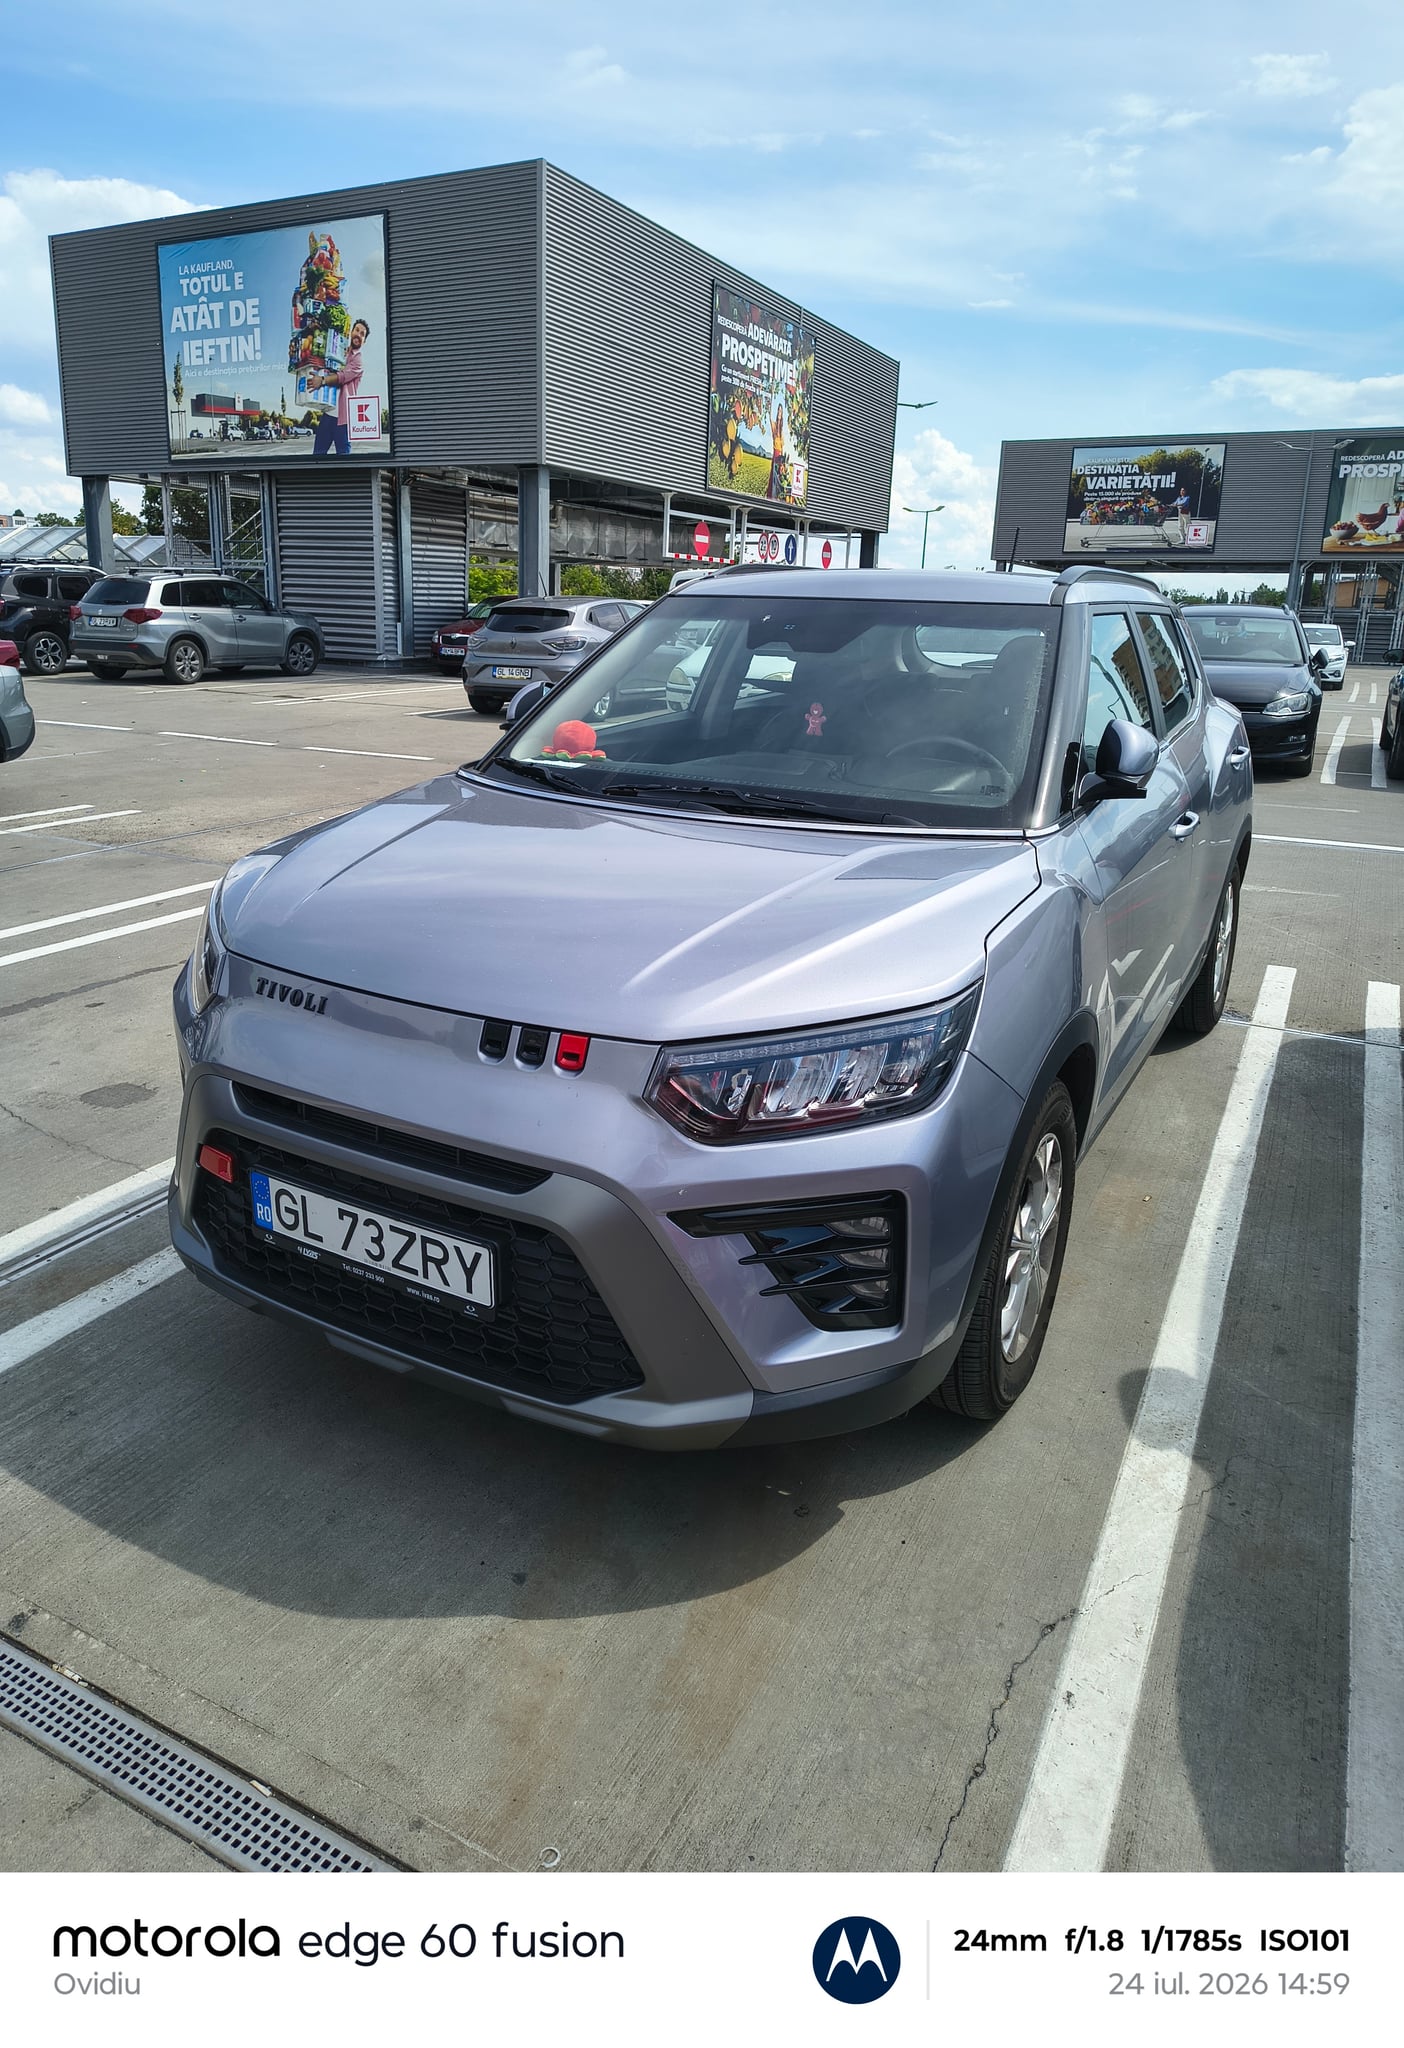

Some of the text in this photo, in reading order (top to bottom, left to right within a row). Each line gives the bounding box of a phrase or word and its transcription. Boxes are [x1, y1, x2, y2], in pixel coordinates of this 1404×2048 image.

[179, 259, 235, 275] LA KAUFLAND,
[180, 272, 244, 297] TOTUL E
[170, 296, 260, 333] ATÂT DE
[183, 328, 261, 367] IEFTIN!
[748, 323, 792, 357] ADEVĂRATA
[185, 369, 196, 377] Aici
[352, 425, 377, 433] Kaufland
[1077, 464, 1140, 475] DESTINAȚIA
[1086, 472, 1177, 491] VARIETĂȚII!
[256, 976, 328, 1015] TIVOLI
[256, 1202, 271, 1222] RO
[275, 1188, 324, 1243] GL
